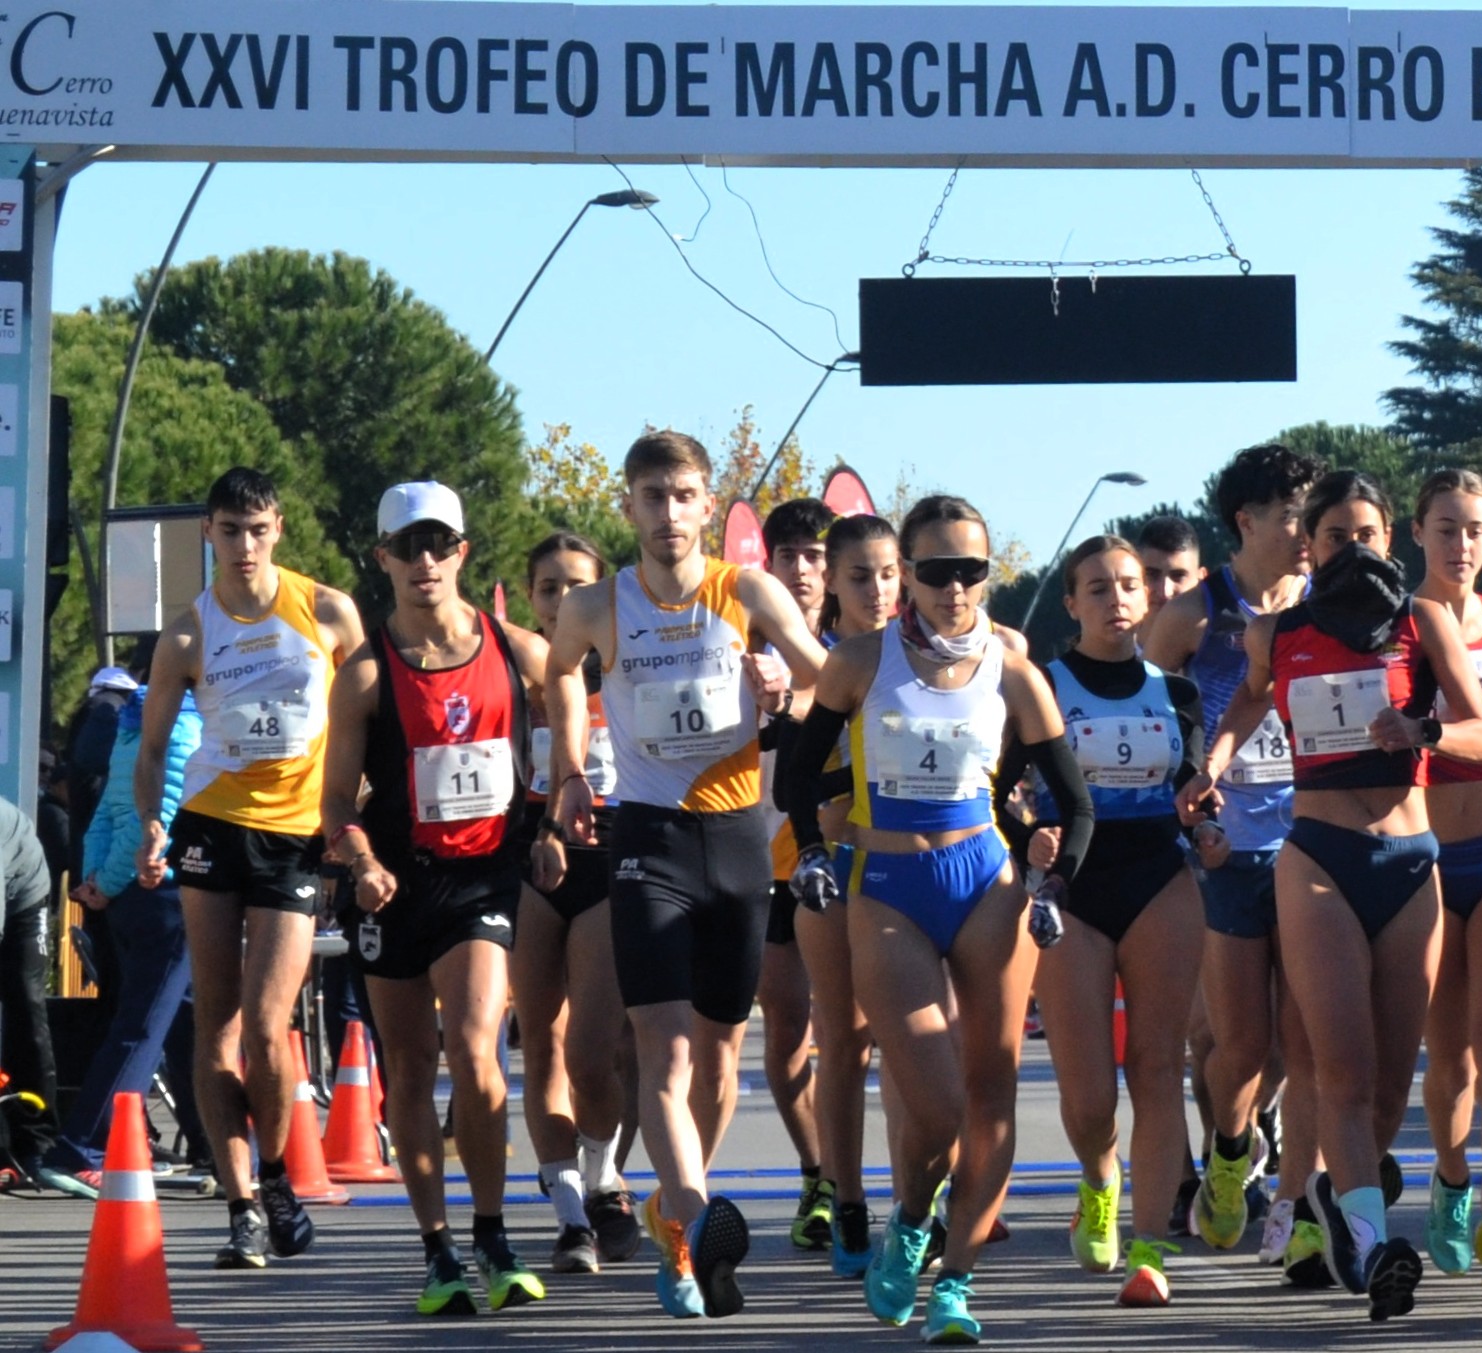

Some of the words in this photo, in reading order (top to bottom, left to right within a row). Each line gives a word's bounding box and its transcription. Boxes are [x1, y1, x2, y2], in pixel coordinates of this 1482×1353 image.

[10, 11, 113, 96] Cerro
[151, 31, 310, 110] XXVI
[333, 36, 599, 118] TROFEO
[625, 42, 710, 117] DE
[734, 41, 1043, 118] MARCHA
[1062, 42, 1197, 118] A.D.
[1220, 42, 1445, 121] CERRO
[0, 102, 115, 127] uenavista
[621, 646, 724, 672] grupompleo
[249, 716, 281, 737] 48
[669, 708, 705, 734] 10
[1332, 703, 1346, 727] 1
[1117, 742, 1132, 765] 9
[1254, 736, 1285, 759] 18
[919, 749, 938, 774] 4
[450, 770, 480, 795] 11
